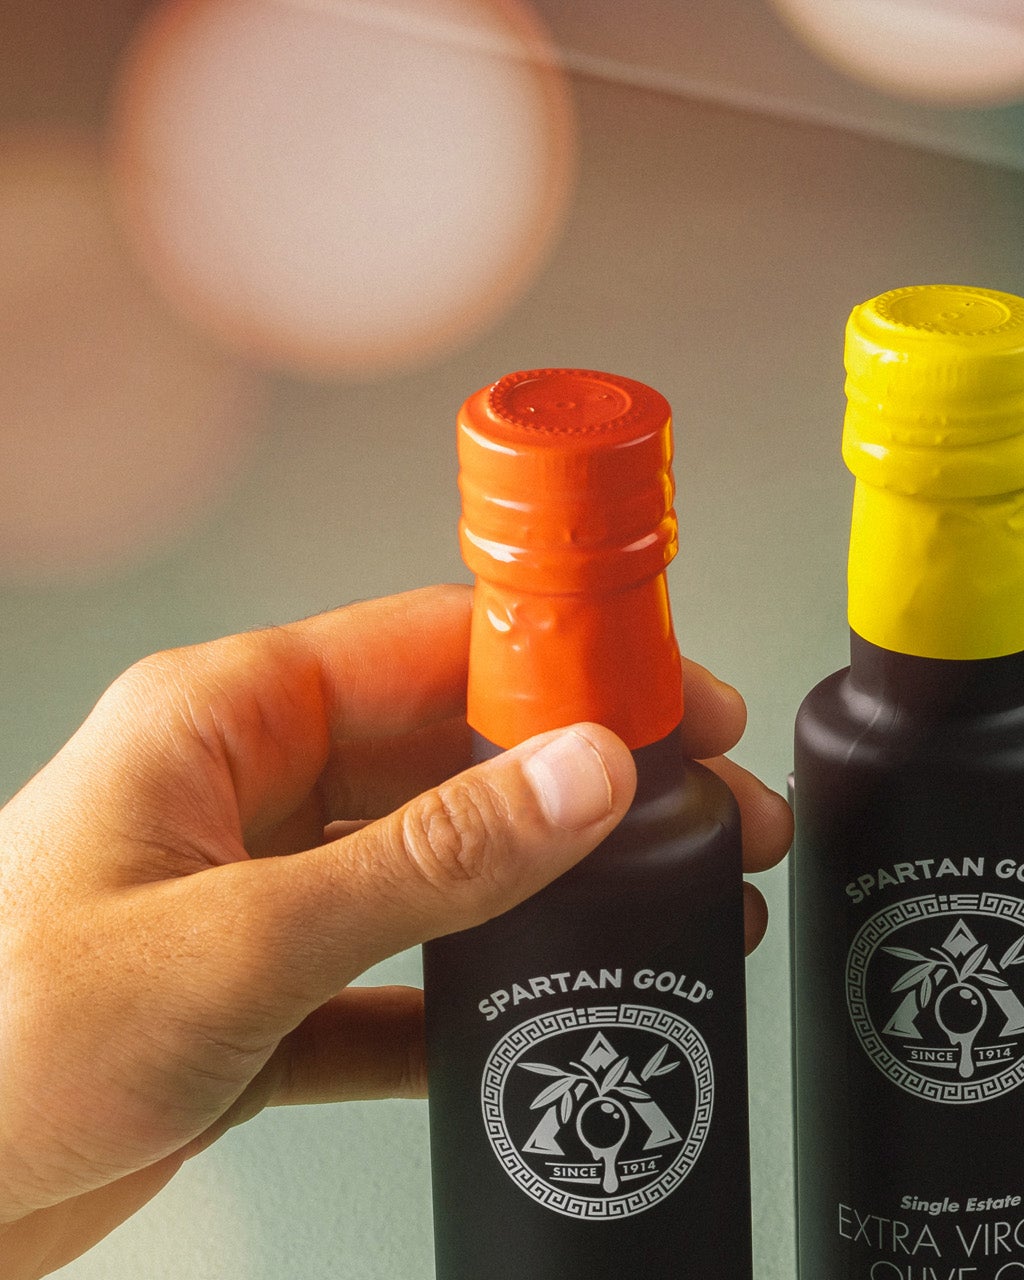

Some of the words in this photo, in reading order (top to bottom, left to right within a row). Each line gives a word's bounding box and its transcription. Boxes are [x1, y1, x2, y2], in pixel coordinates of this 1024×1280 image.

[845, 857, 985, 904] SPARTAN
[478, 968, 623, 1022] SPARTAN
[911, 1050, 954, 1062] SINCE
[978, 1048, 1012, 1060] 1914
[552, 1166, 597, 1178] SINCE
[622, 1160, 656, 1174] 1914
[900, 1195, 960, 1216] Single
[965, 1194, 1022, 1213] Estate
[838, 1202, 942, 1258] EXTRA
